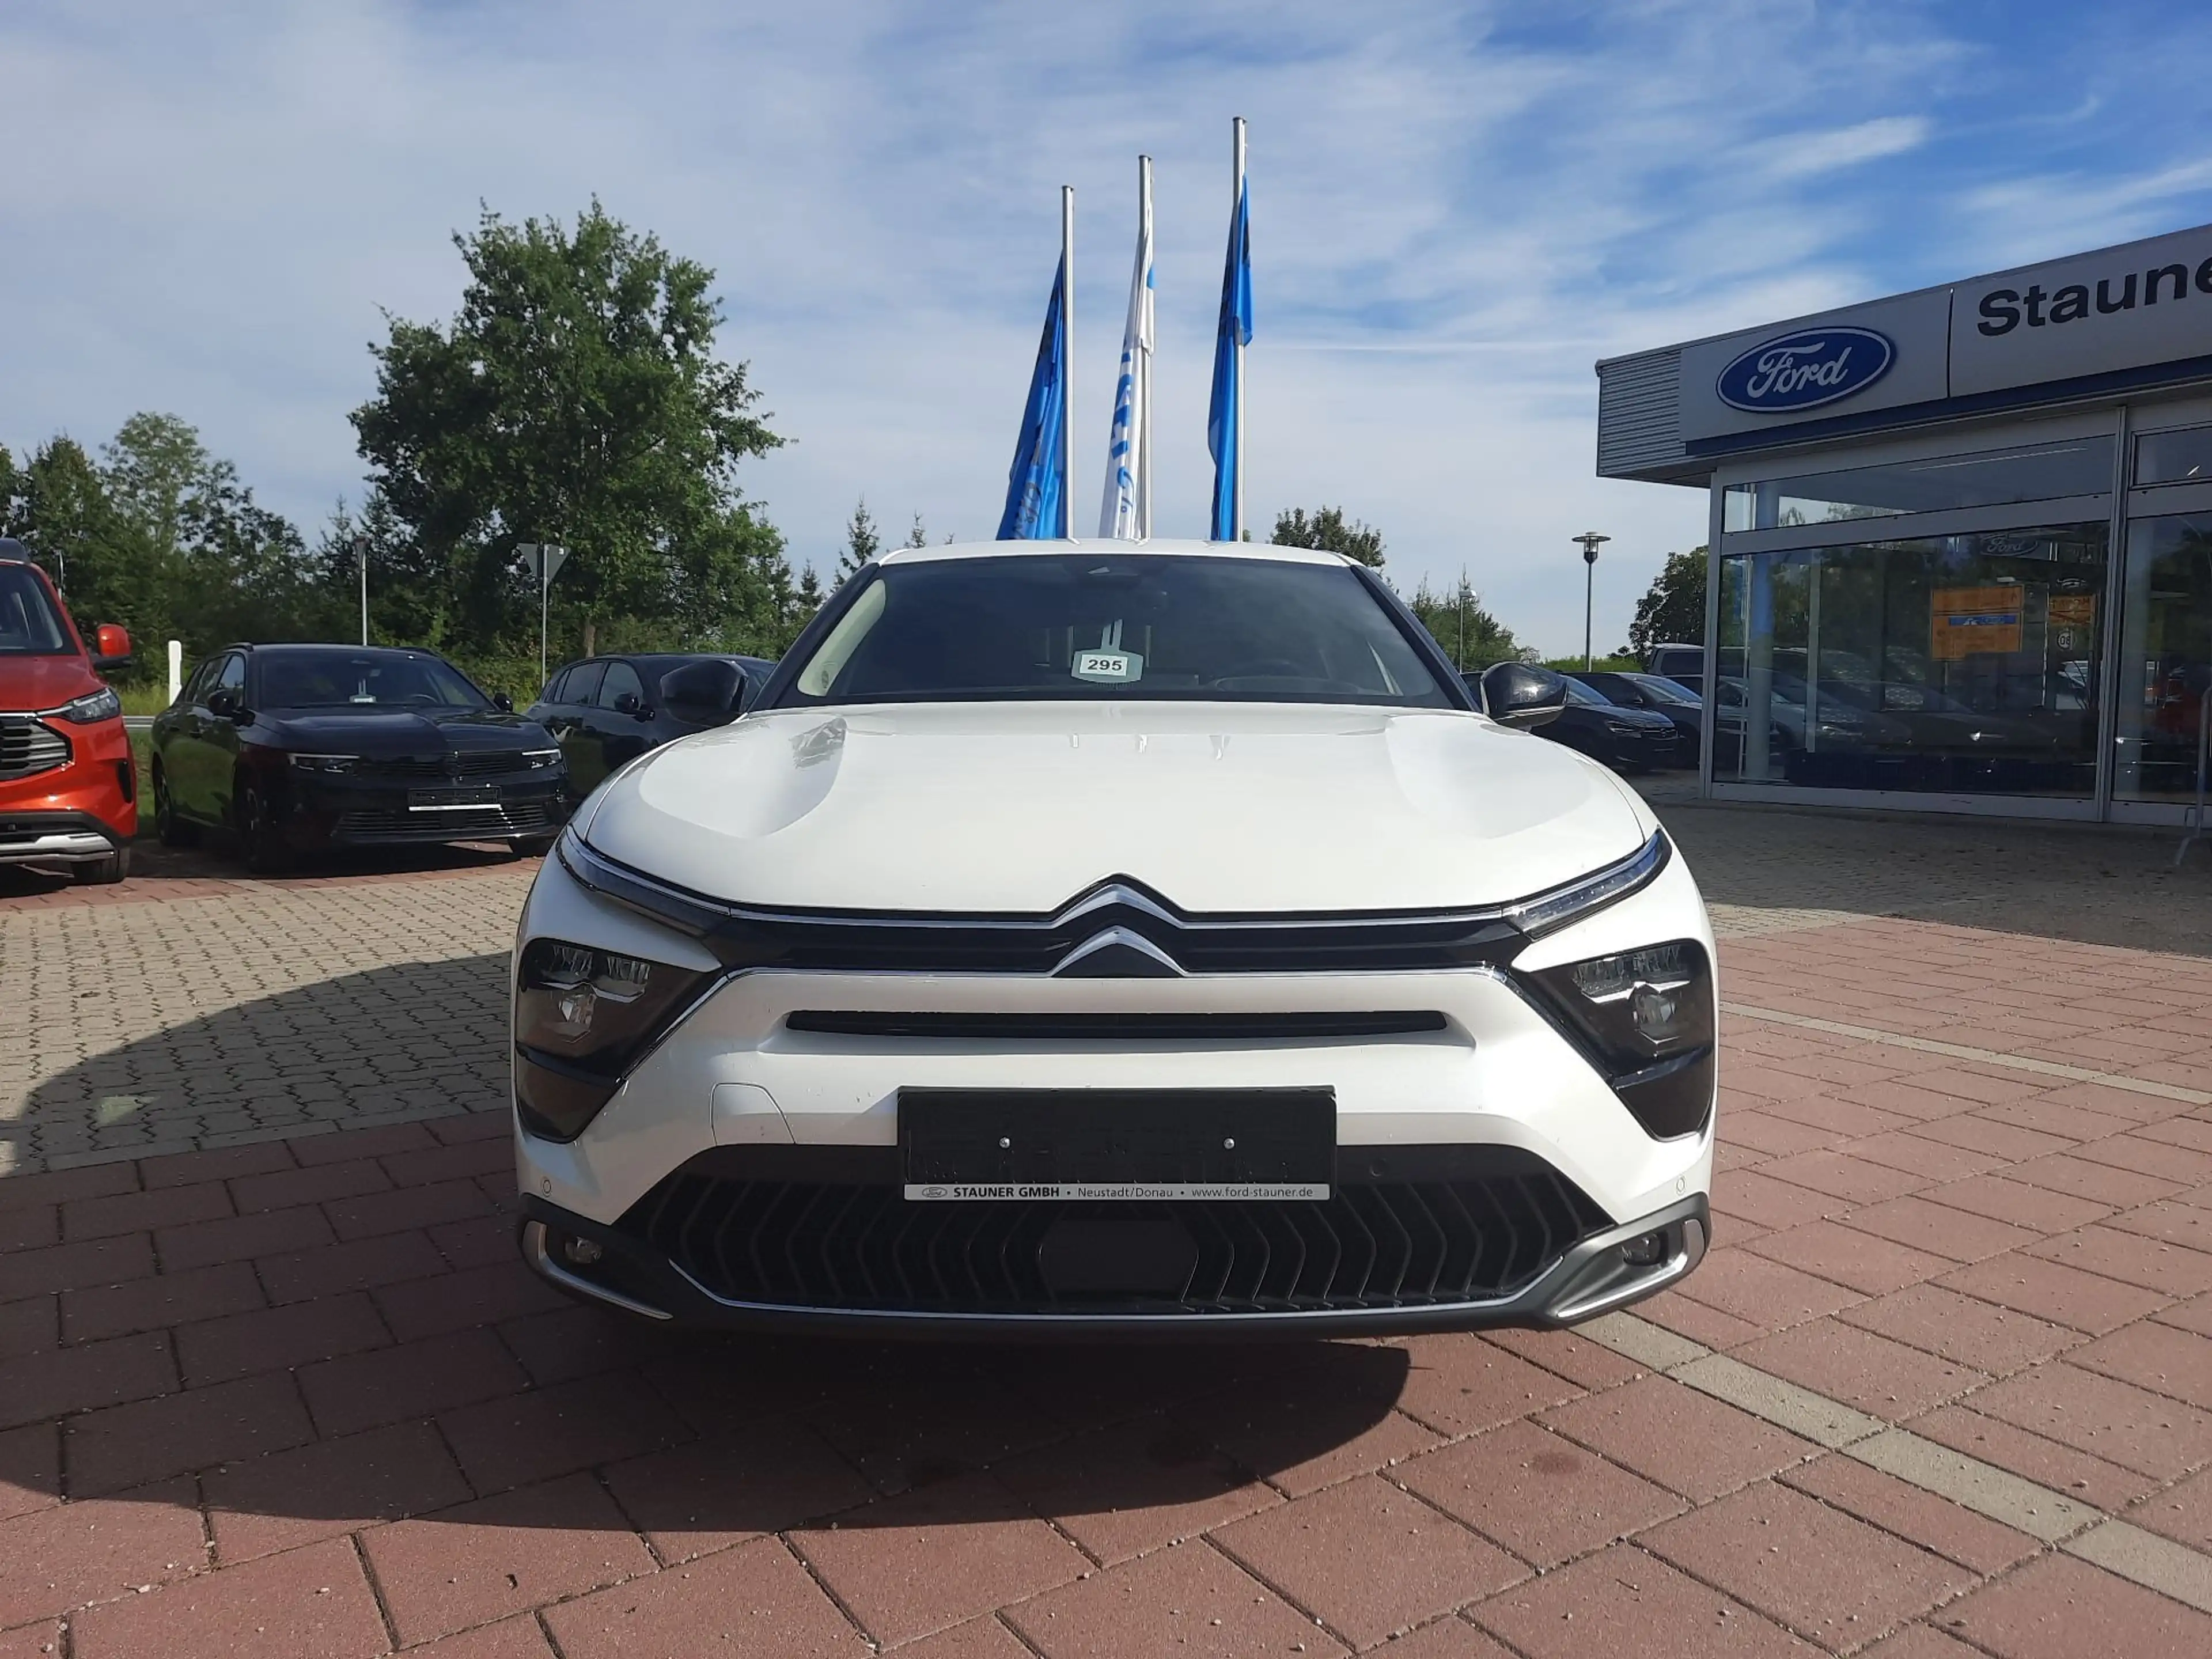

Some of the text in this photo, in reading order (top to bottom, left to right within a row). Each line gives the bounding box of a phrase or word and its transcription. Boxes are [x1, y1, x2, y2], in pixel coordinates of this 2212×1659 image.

[1746, 342, 1853, 398] Ford
[1087, 659, 1122, 671] 295
[953, 1187, 1014, 1198] STAUNER
[1018, 1187, 1060, 1198] GMBH
[1077, 1187, 1173, 1199] Neustadt/Donau
[1191, 1187, 1313, 1198] www.ford-stauner.de
